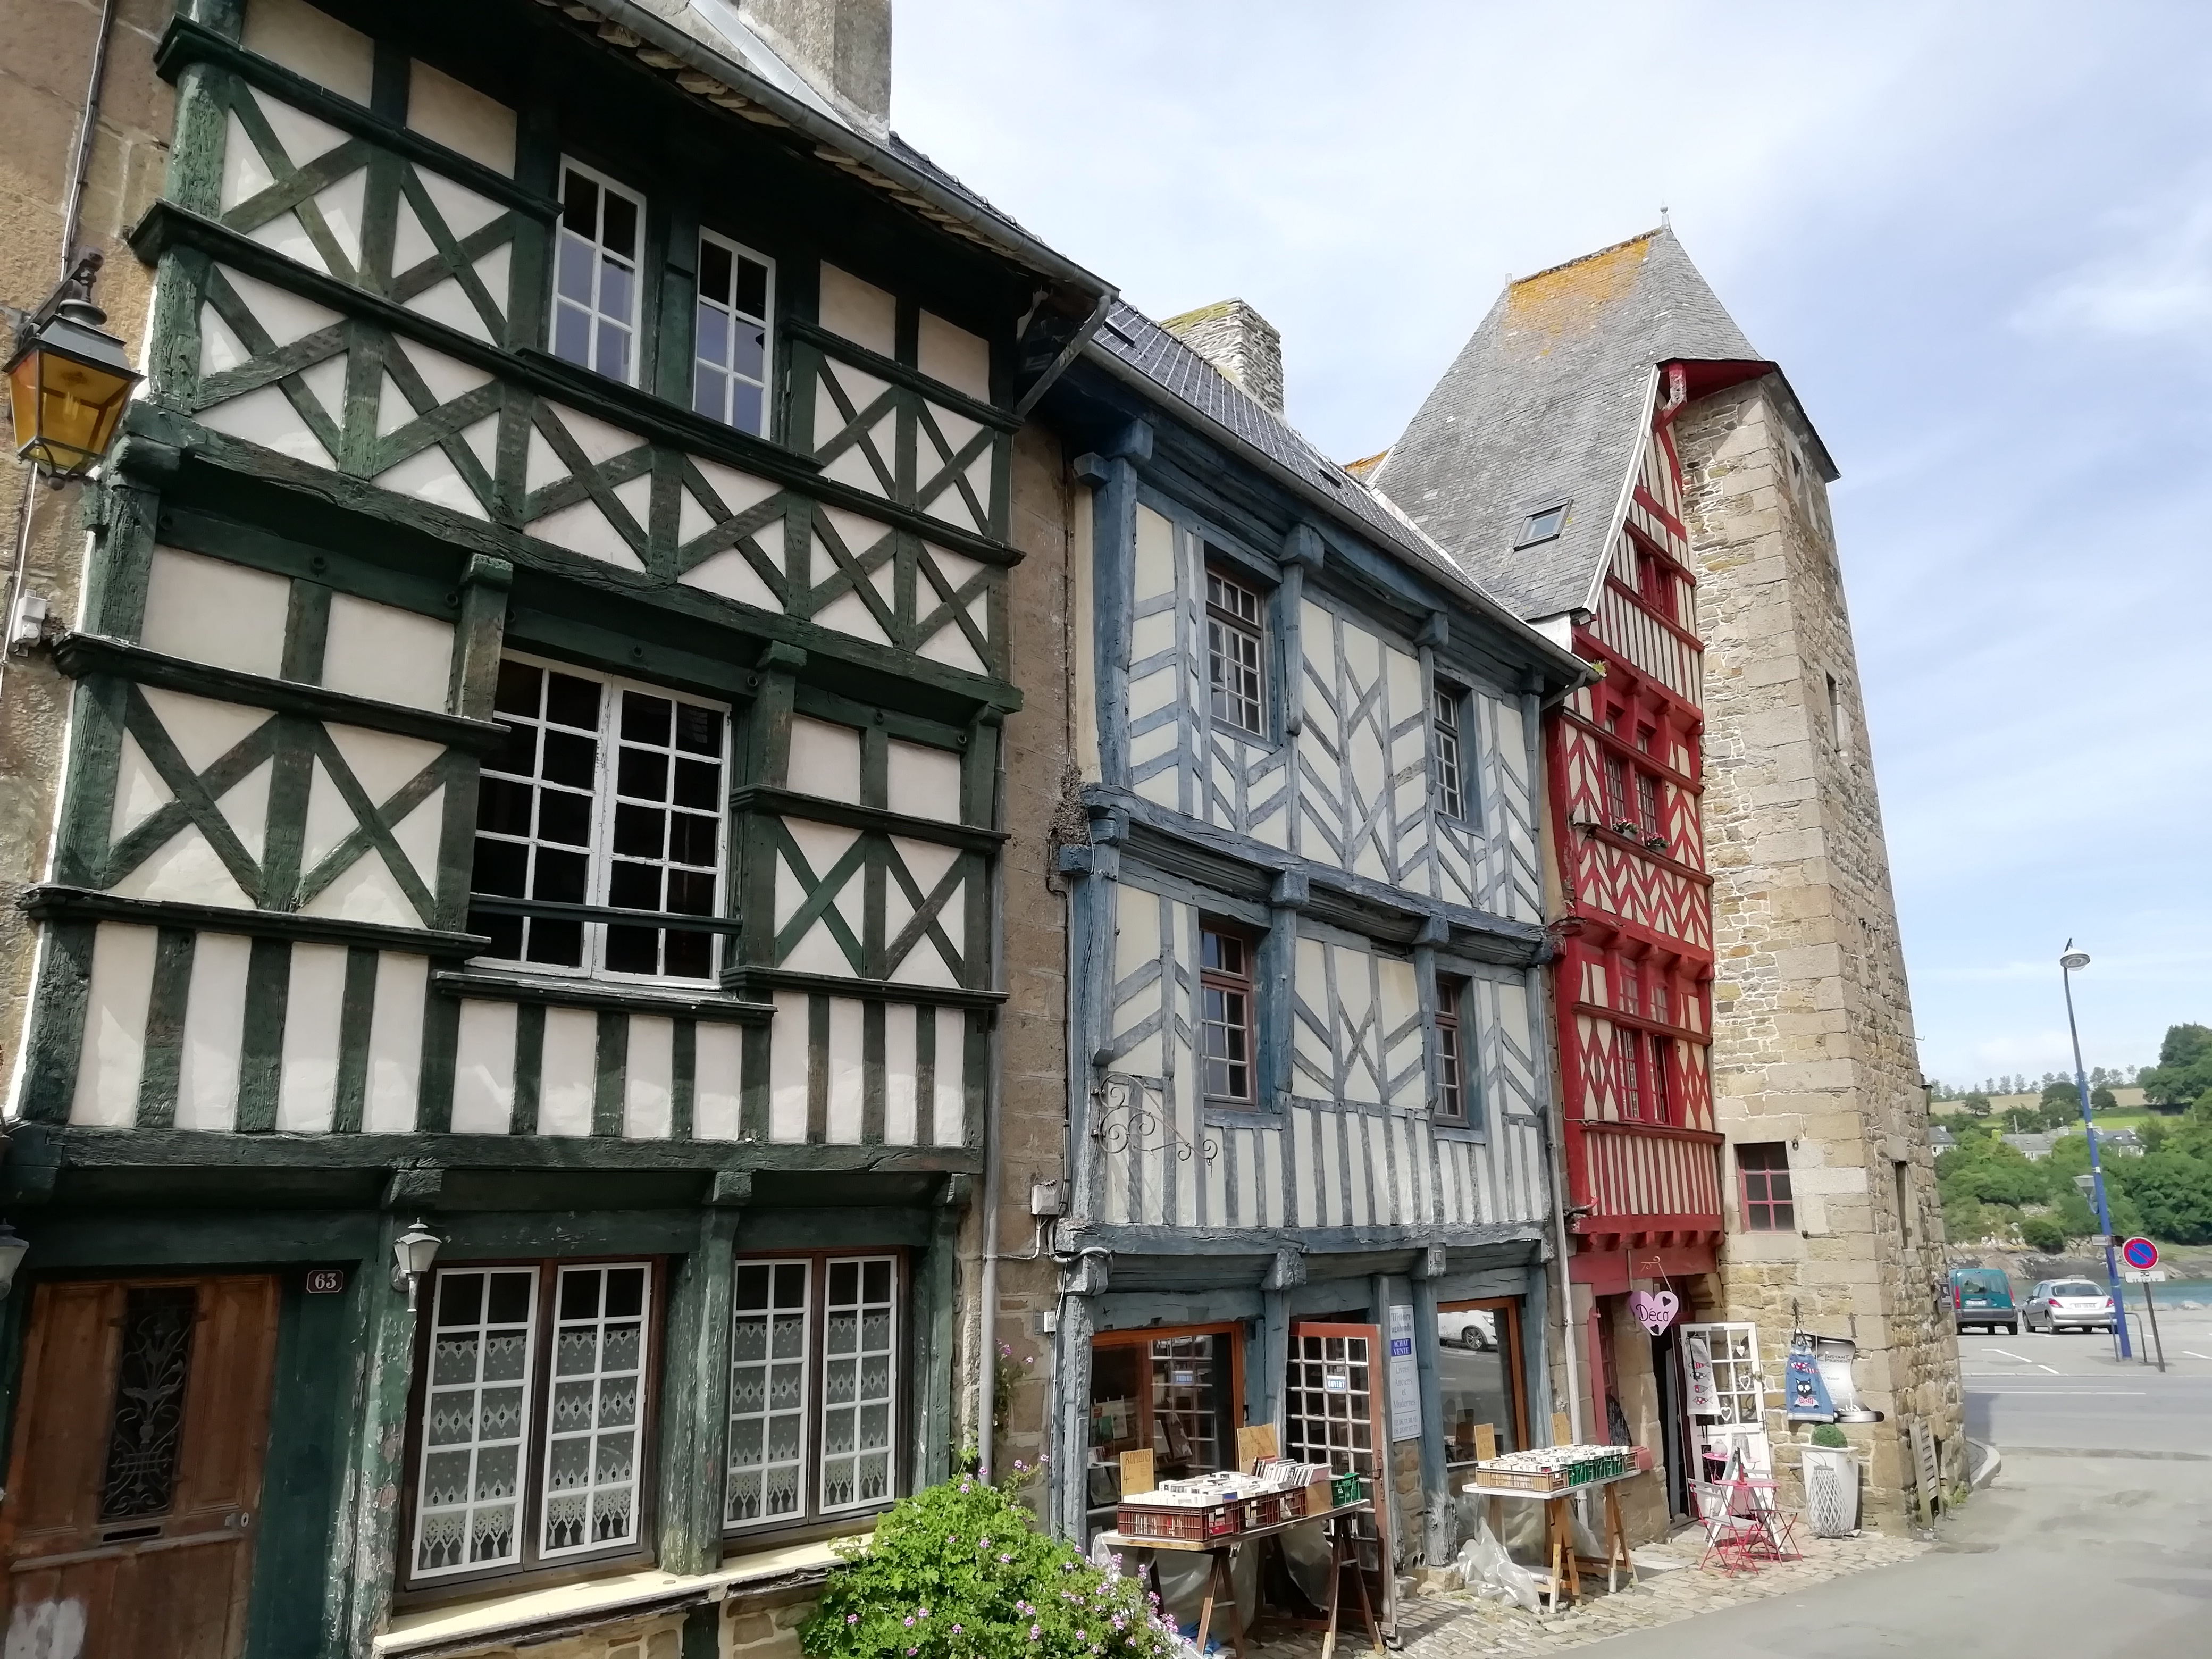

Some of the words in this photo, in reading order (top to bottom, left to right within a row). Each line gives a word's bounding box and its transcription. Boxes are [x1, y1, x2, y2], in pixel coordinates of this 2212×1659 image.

[315, 1273, 336, 1289] 63
[1636, 1304, 1669, 1322] Déco
[1393, 1339, 1409, 1348] ACHAT
[1393, 1347, 1410, 1355] VENTE
[1396, 1365, 1409, 1375] Livres
[1395, 1377, 1412, 1387] Anciens
[1393, 1398, 1416, 1409] Modernes
[1125, 1449, 1151, 1465] ROMANS
